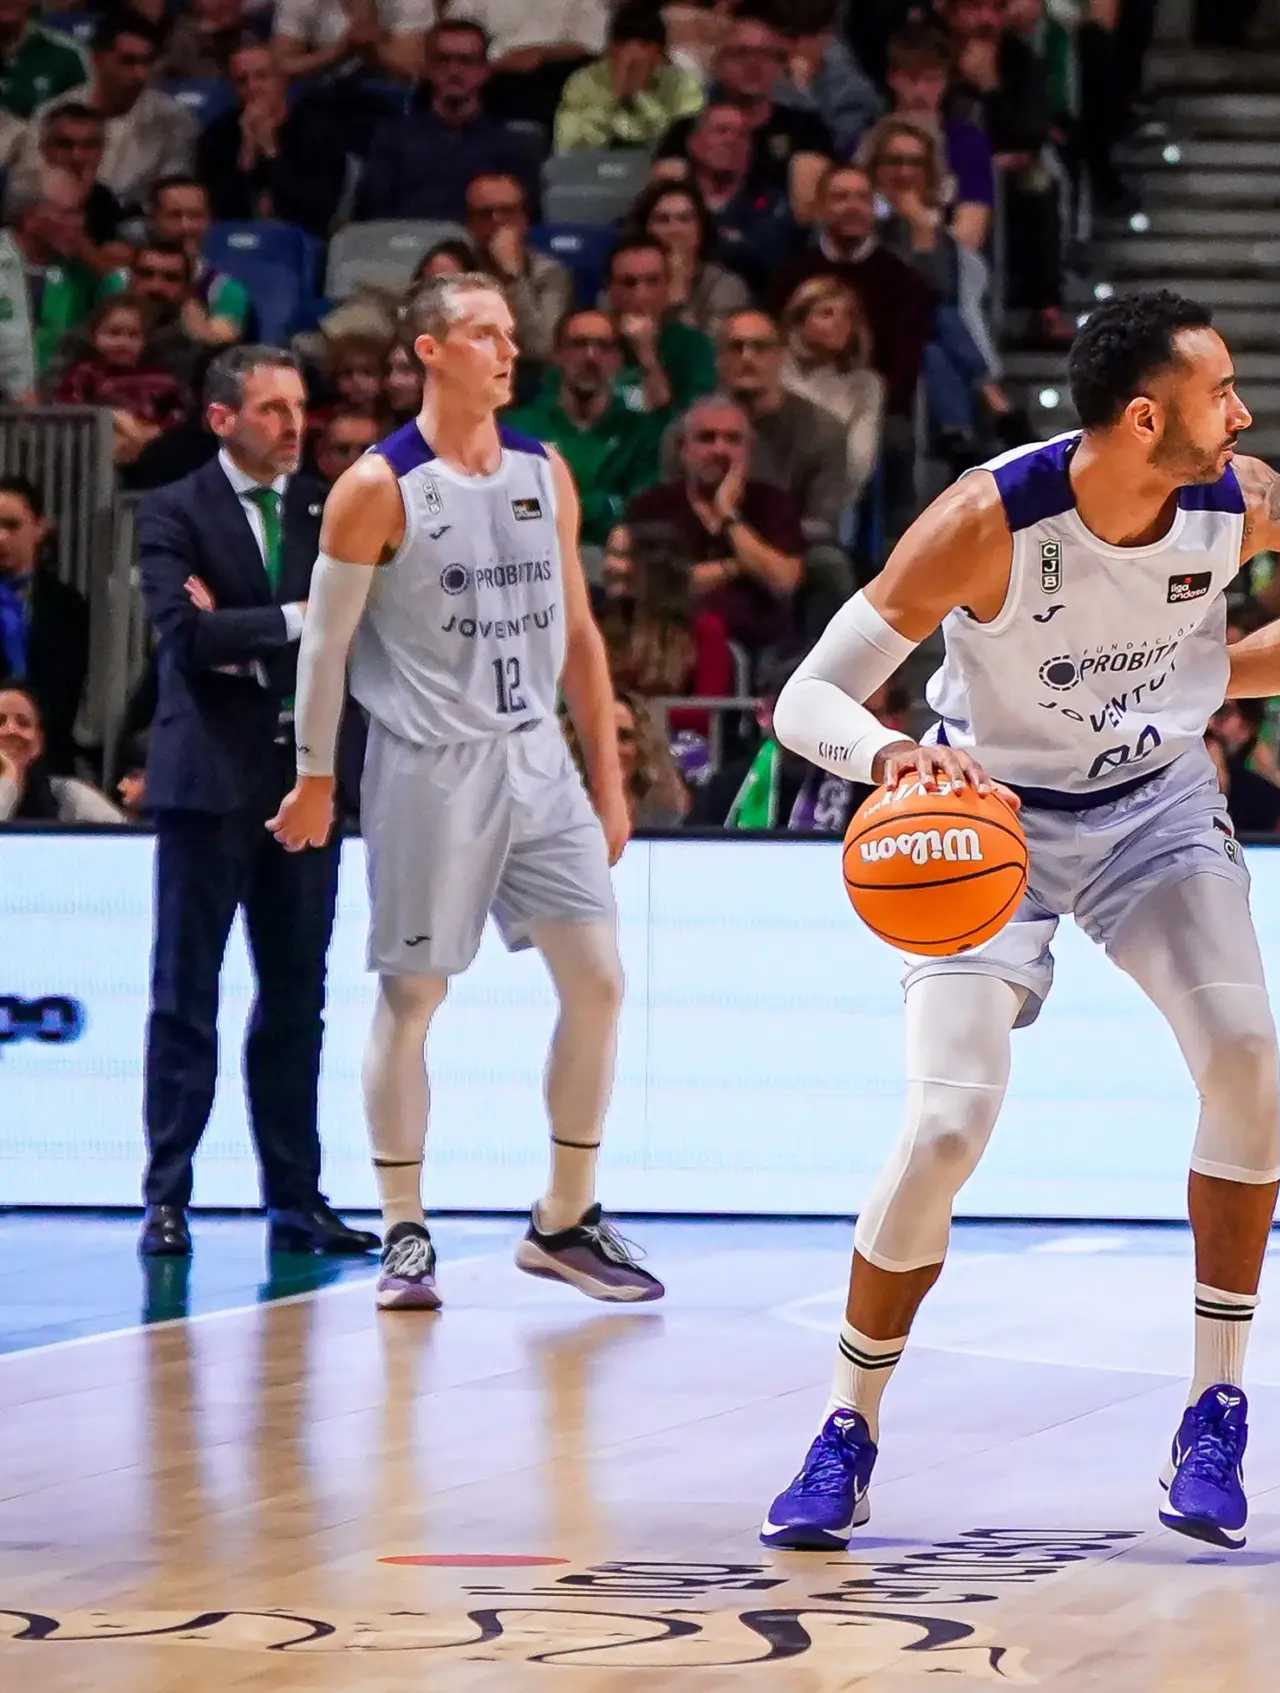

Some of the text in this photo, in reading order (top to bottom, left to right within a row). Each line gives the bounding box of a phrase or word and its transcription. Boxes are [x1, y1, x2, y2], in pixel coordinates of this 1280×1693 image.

[475, 560, 552, 590] PROBITAS
[1079, 640, 1178, 681] PROBITA
[492, 656, 528, 714] 12
[860, 827, 984, 866] Wilson
